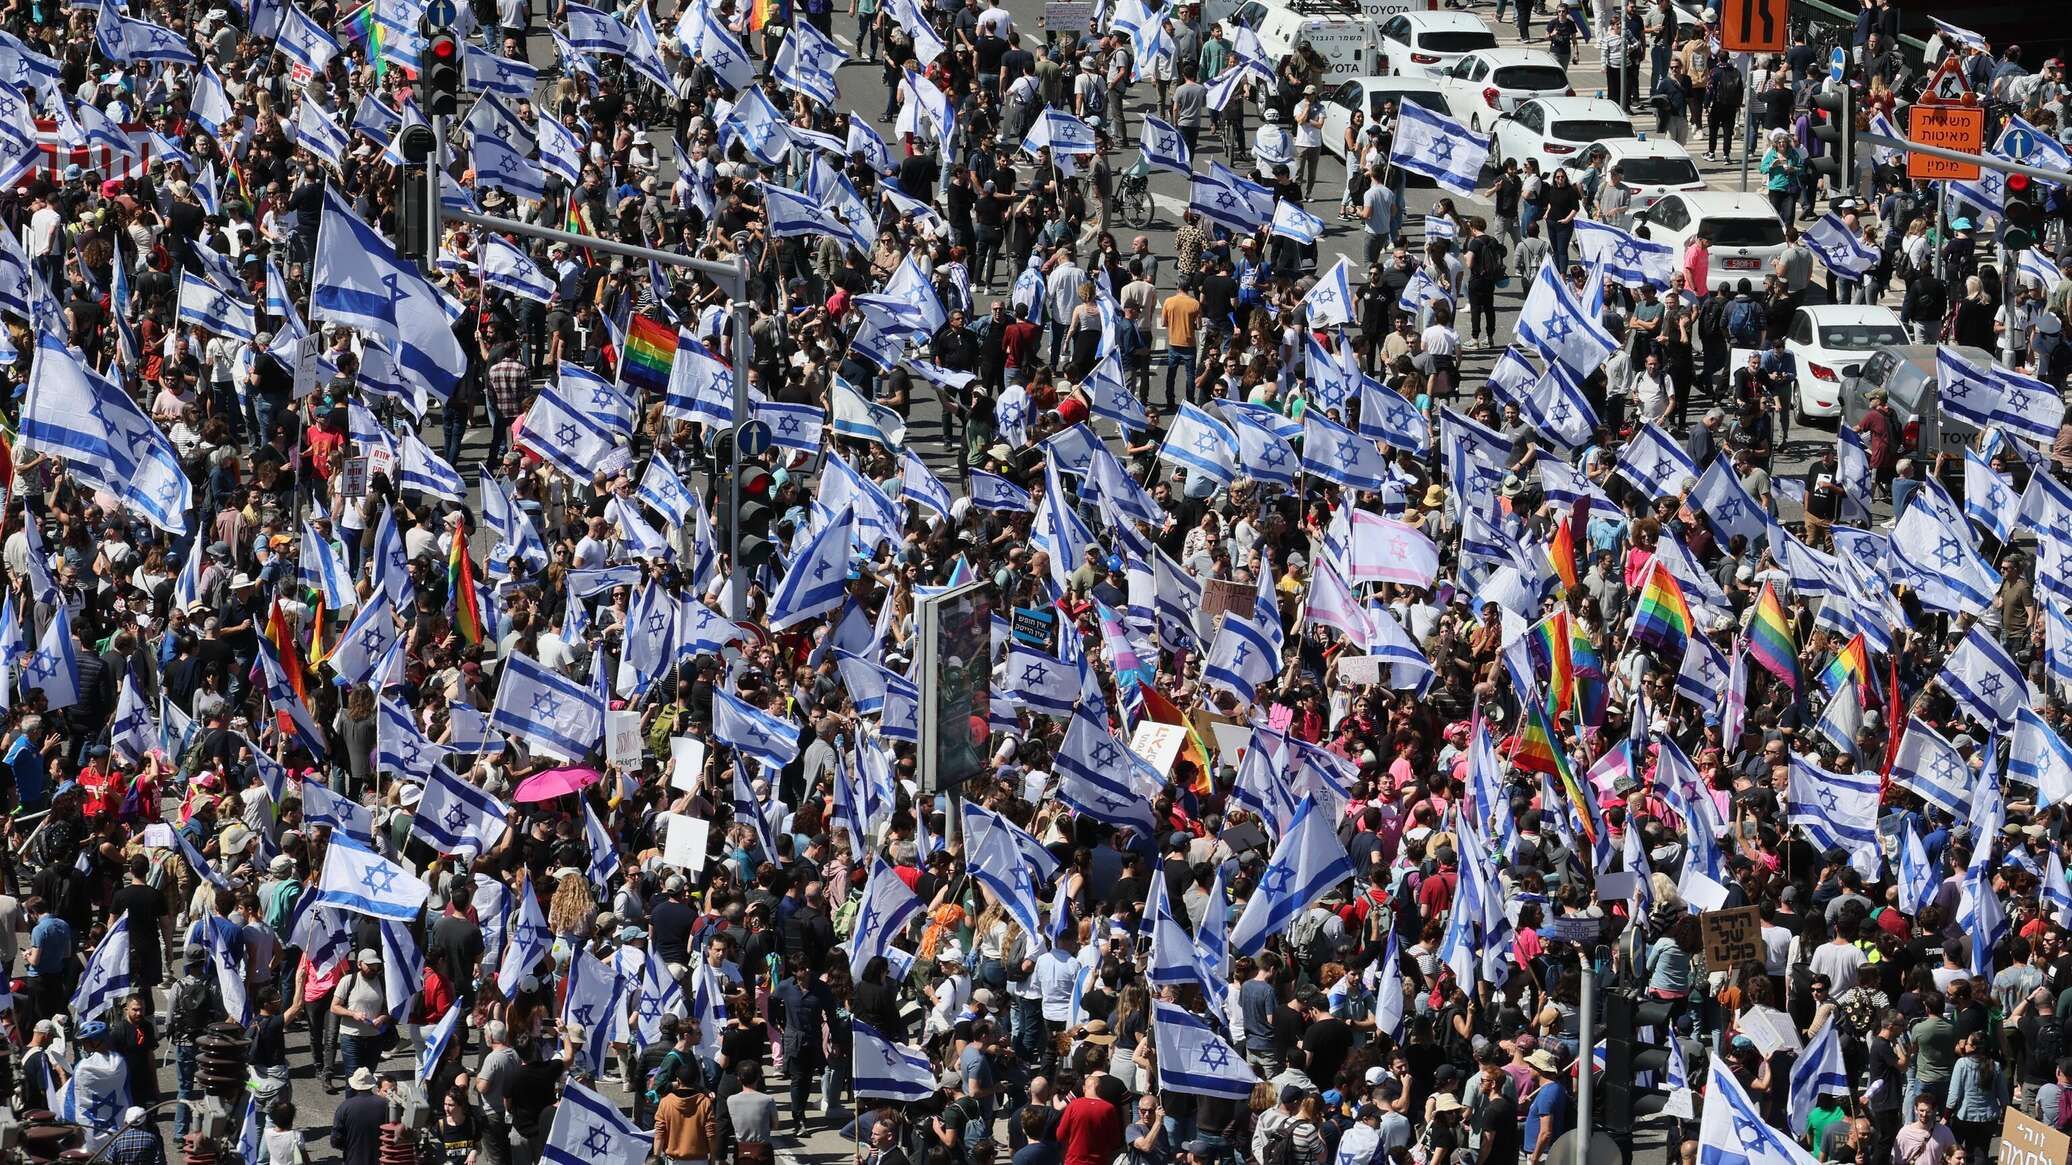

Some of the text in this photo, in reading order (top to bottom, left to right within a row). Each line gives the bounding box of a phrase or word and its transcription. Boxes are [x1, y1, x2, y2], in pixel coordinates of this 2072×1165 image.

[1364, 5, 1409, 15] TOYOTA
[1330, 63, 1360, 73] YOTA
[1921, 115, 1971, 128] משאיות
[1921, 130, 1970, 142] מאיטות
[1927, 160, 1960, 173] מימין
[1018, 615, 1047, 629] אין חופש
[1014, 623, 1045, 639] אין הייטק
[1719, 928, 1744, 945] של
[1713, 942, 1756, 962] כולנו
[2016, 1123, 2045, 1148] זוהי
[2000, 1140, 2053, 1165] לחמה
